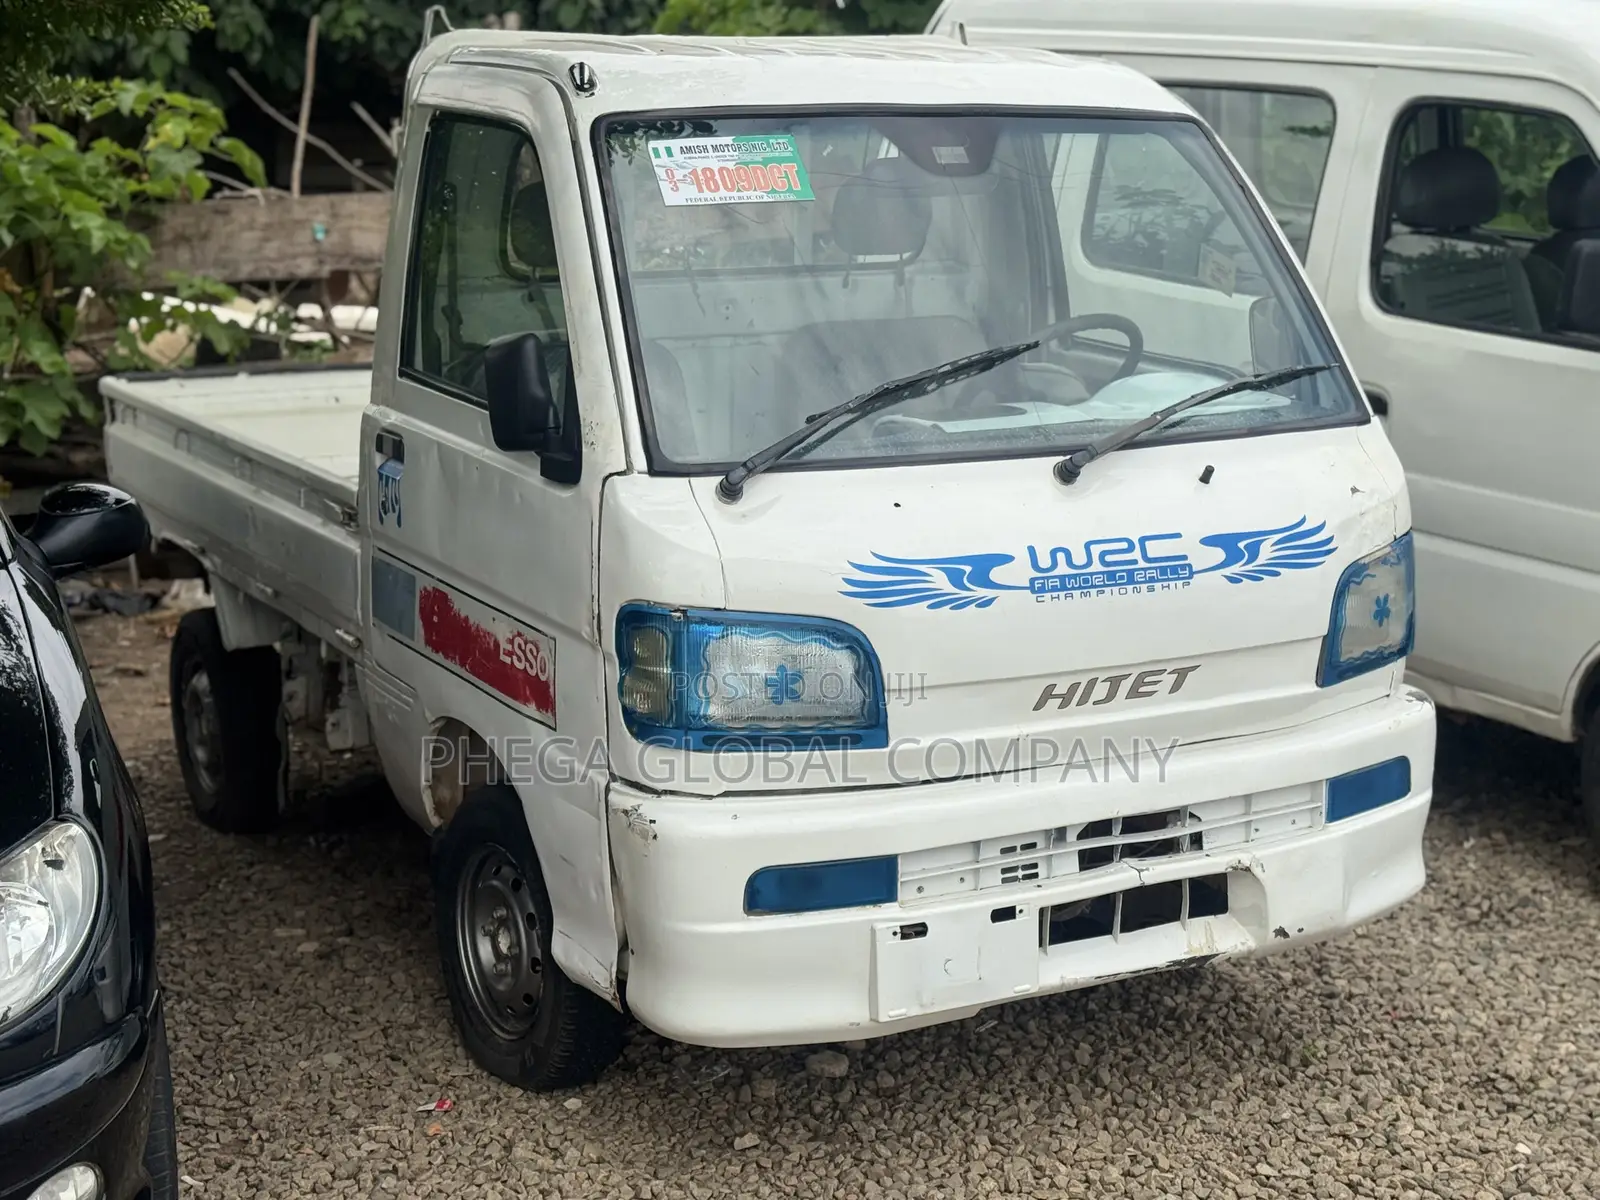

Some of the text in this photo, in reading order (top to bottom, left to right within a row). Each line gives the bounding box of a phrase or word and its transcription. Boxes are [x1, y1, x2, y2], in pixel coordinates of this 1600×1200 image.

[680, 144, 709, 155] AMISH
[710, 142, 749, 154] MOTORS
[688, 163, 802, 193] 1809DCT
[1034, 566, 1190, 591] FIA WORLD RALLY
[1035, 581, 1191, 603] CHAMPIONSHIP
[1032, 664, 1203, 712] HIJET
